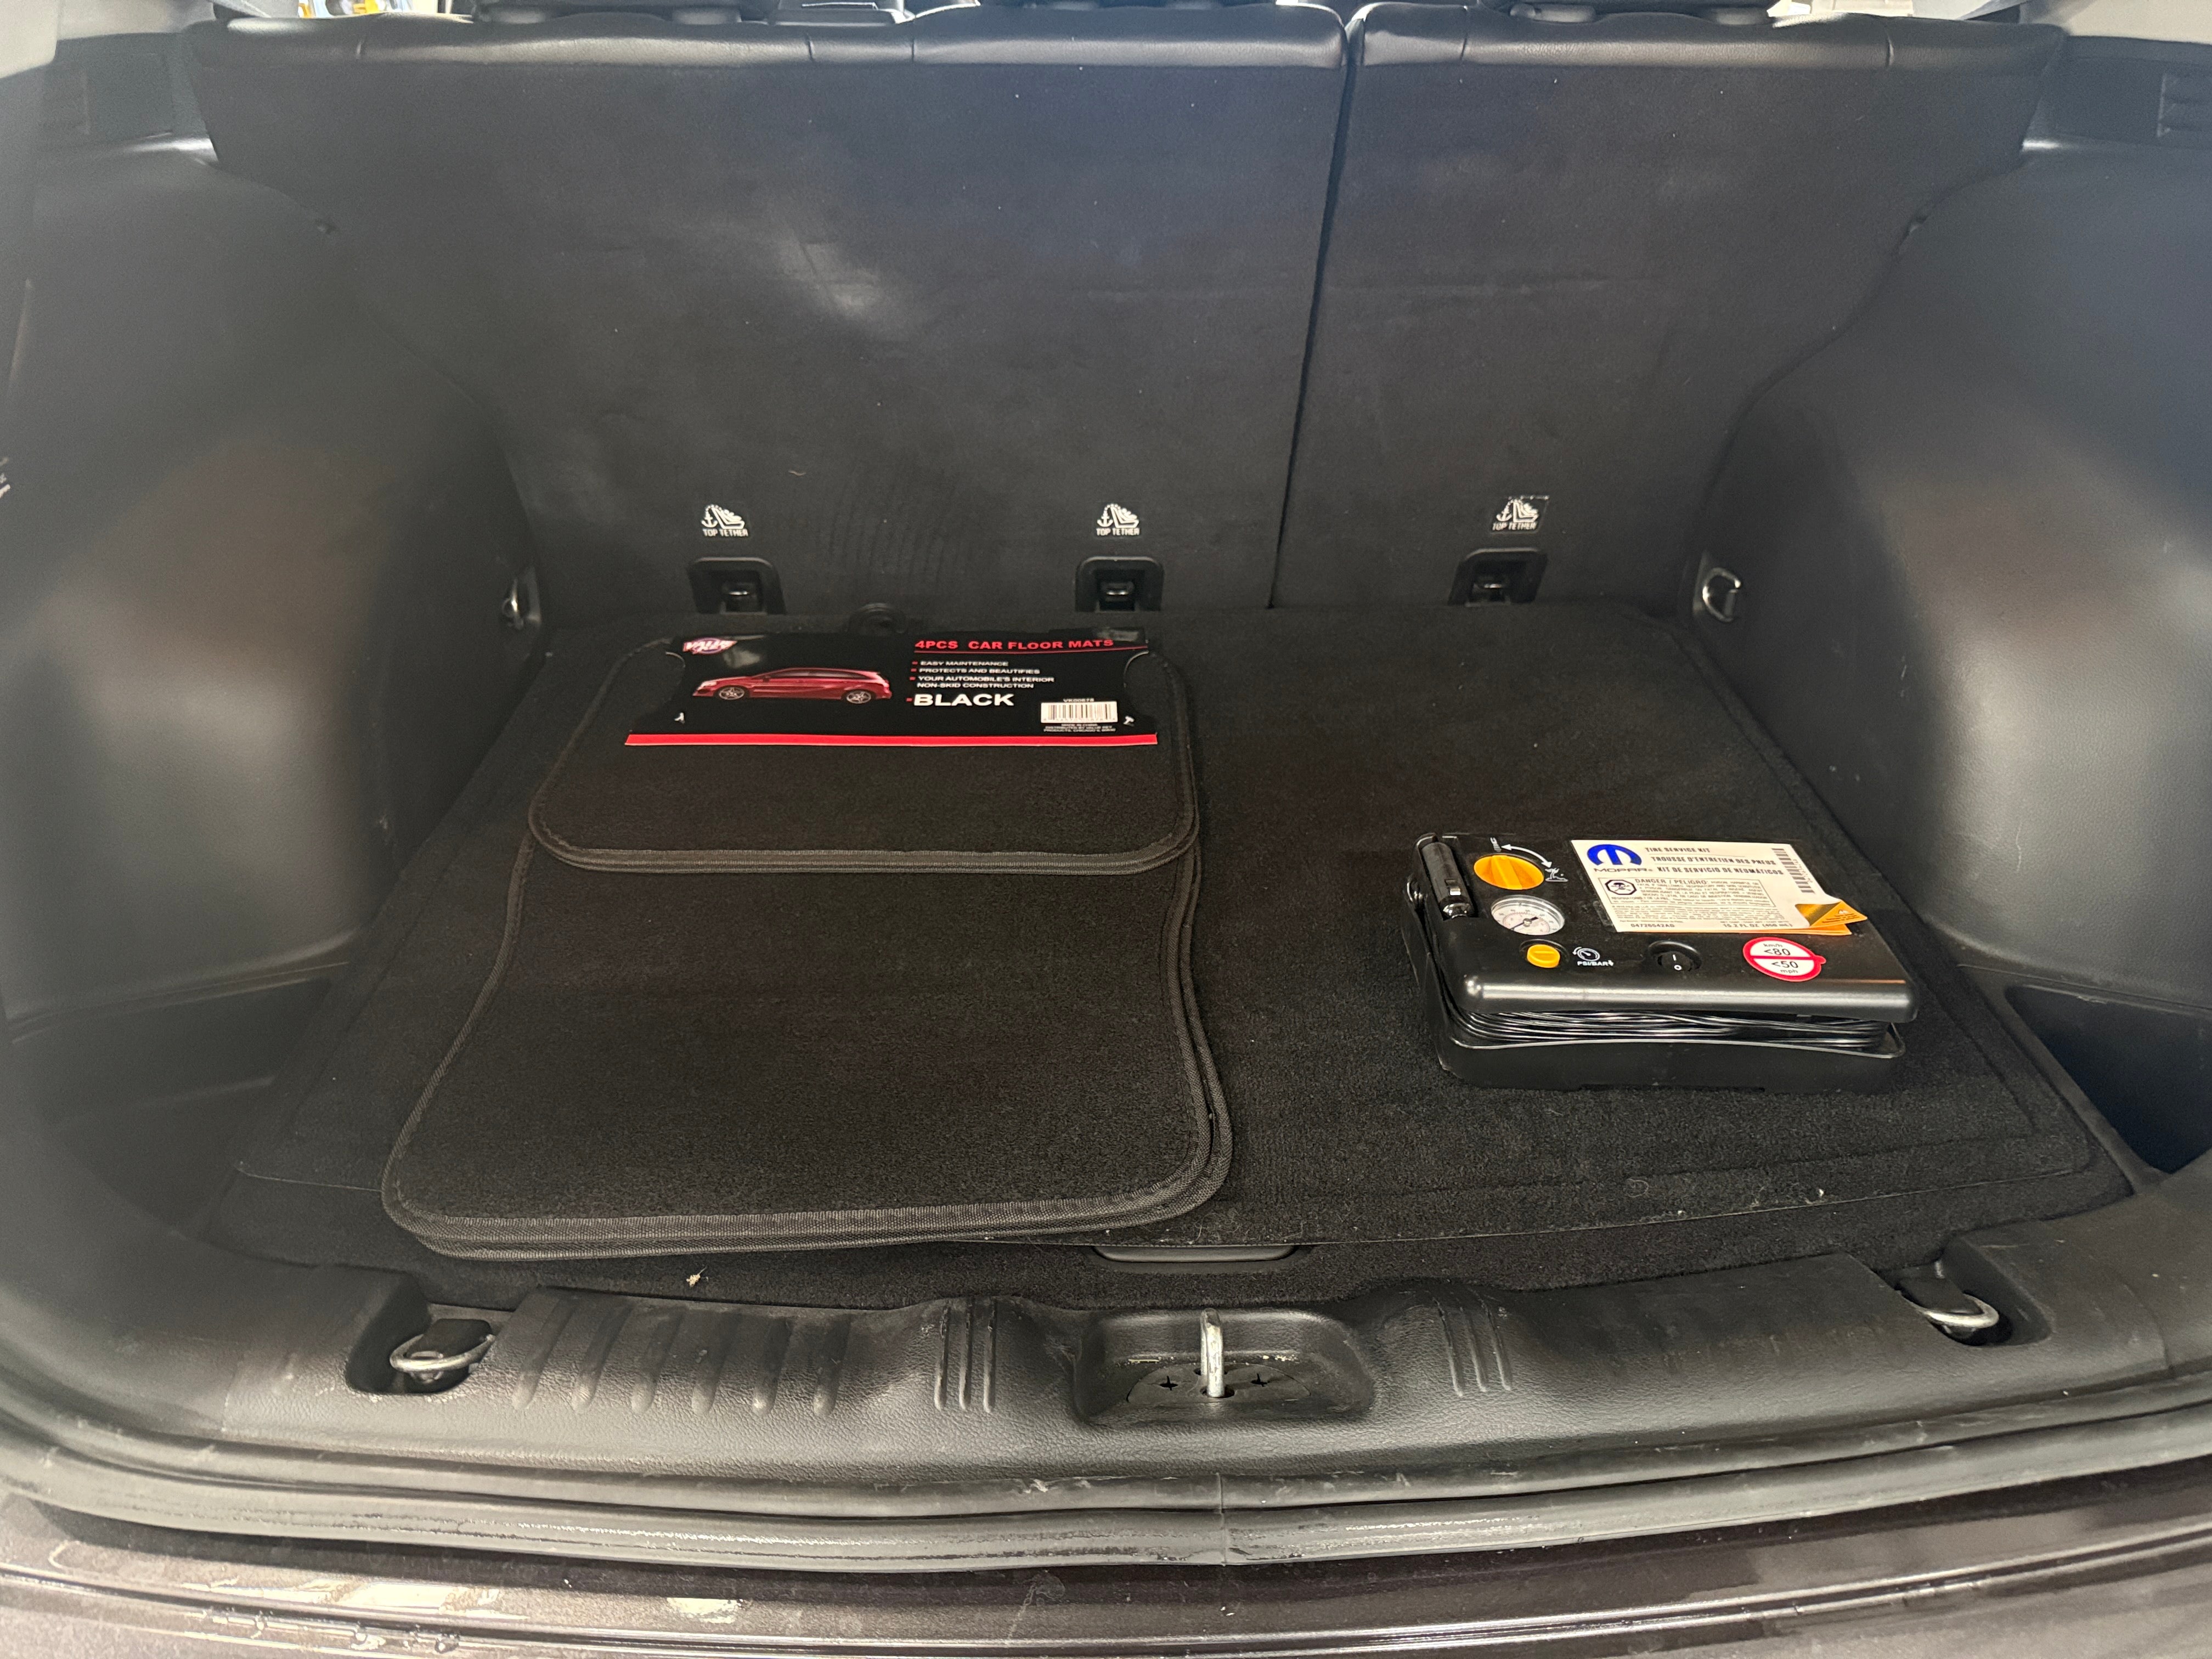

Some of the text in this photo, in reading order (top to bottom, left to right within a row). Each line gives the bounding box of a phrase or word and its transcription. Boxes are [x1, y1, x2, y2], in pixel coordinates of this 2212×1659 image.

[1509, 522, 1537, 530] TETHER
[702, 528, 748, 537] TOP TETHER
[915, 639, 1114, 650] 4PCS CAR FLOOR MATS
[914, 693, 1014, 706] BLACK
